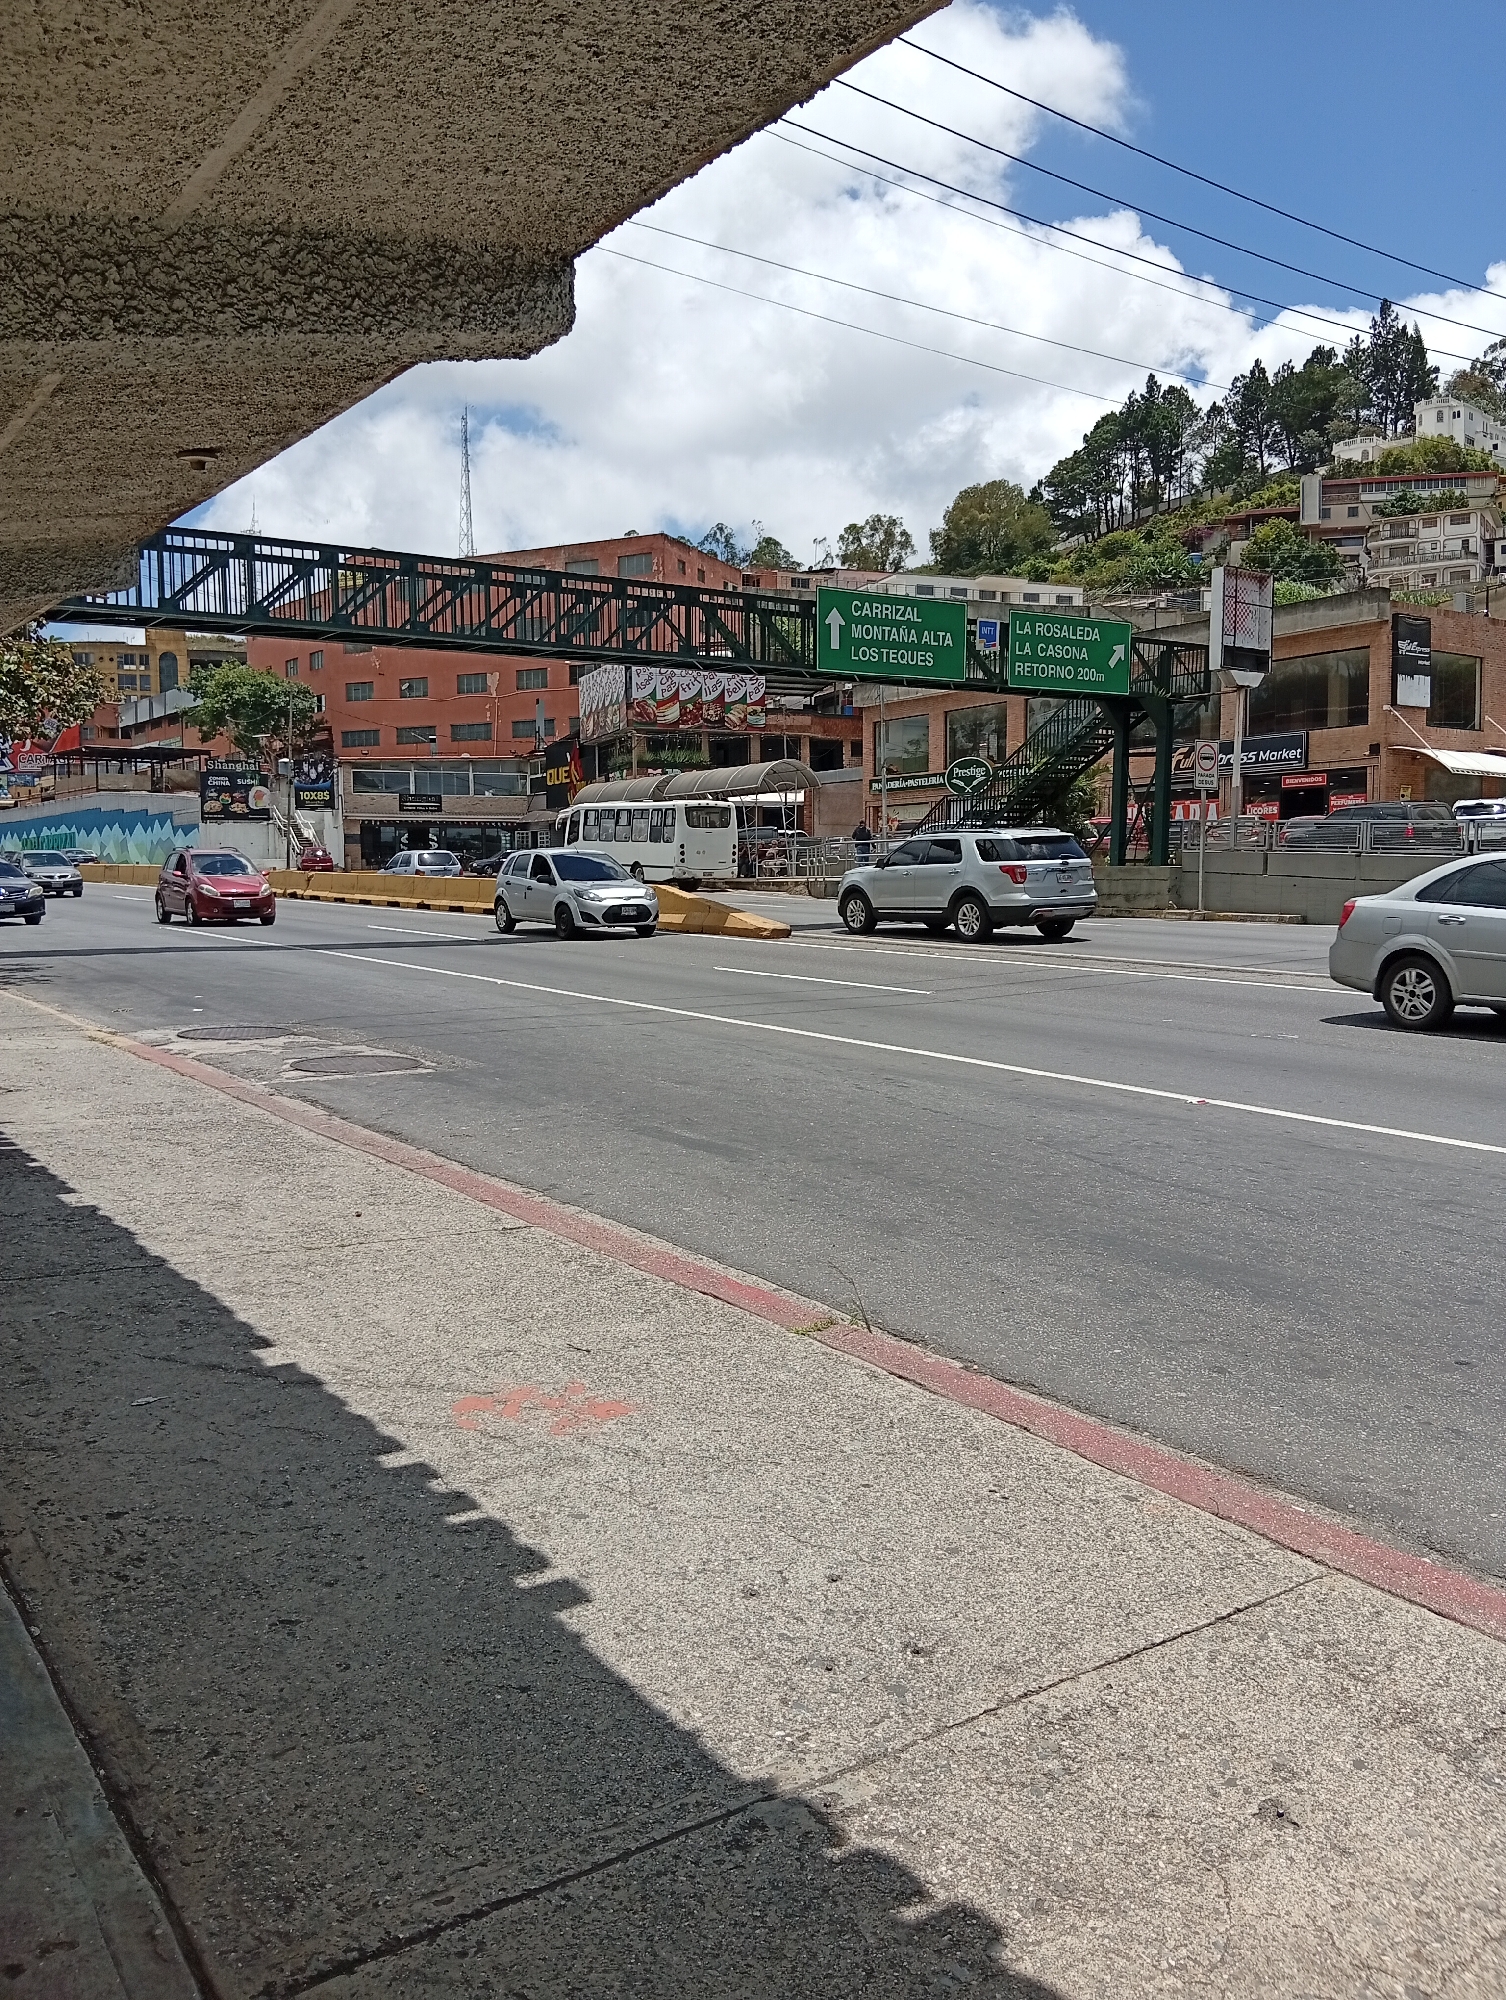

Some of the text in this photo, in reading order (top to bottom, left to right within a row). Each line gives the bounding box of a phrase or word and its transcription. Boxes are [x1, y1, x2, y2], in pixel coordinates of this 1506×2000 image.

[851, 600, 922, 622] CARRIZAL
[851, 623, 954, 647] MONTAÑA ALTA
[1015, 620, 1101, 642] LA ROSALEDA
[851, 646, 934, 667] LOS TEQUES
[1015, 641, 1088, 661] LA CASONA
[1015, 662, 1105, 682] RETORNO 200m
[1258, 748, 1302, 761] Market
[207, 760, 260, 772] Shanghai
[952, 765, 986, 778] Prestige
[299, 790, 330, 800] 10X8$
[1246, 806, 1278, 816] LICORES
